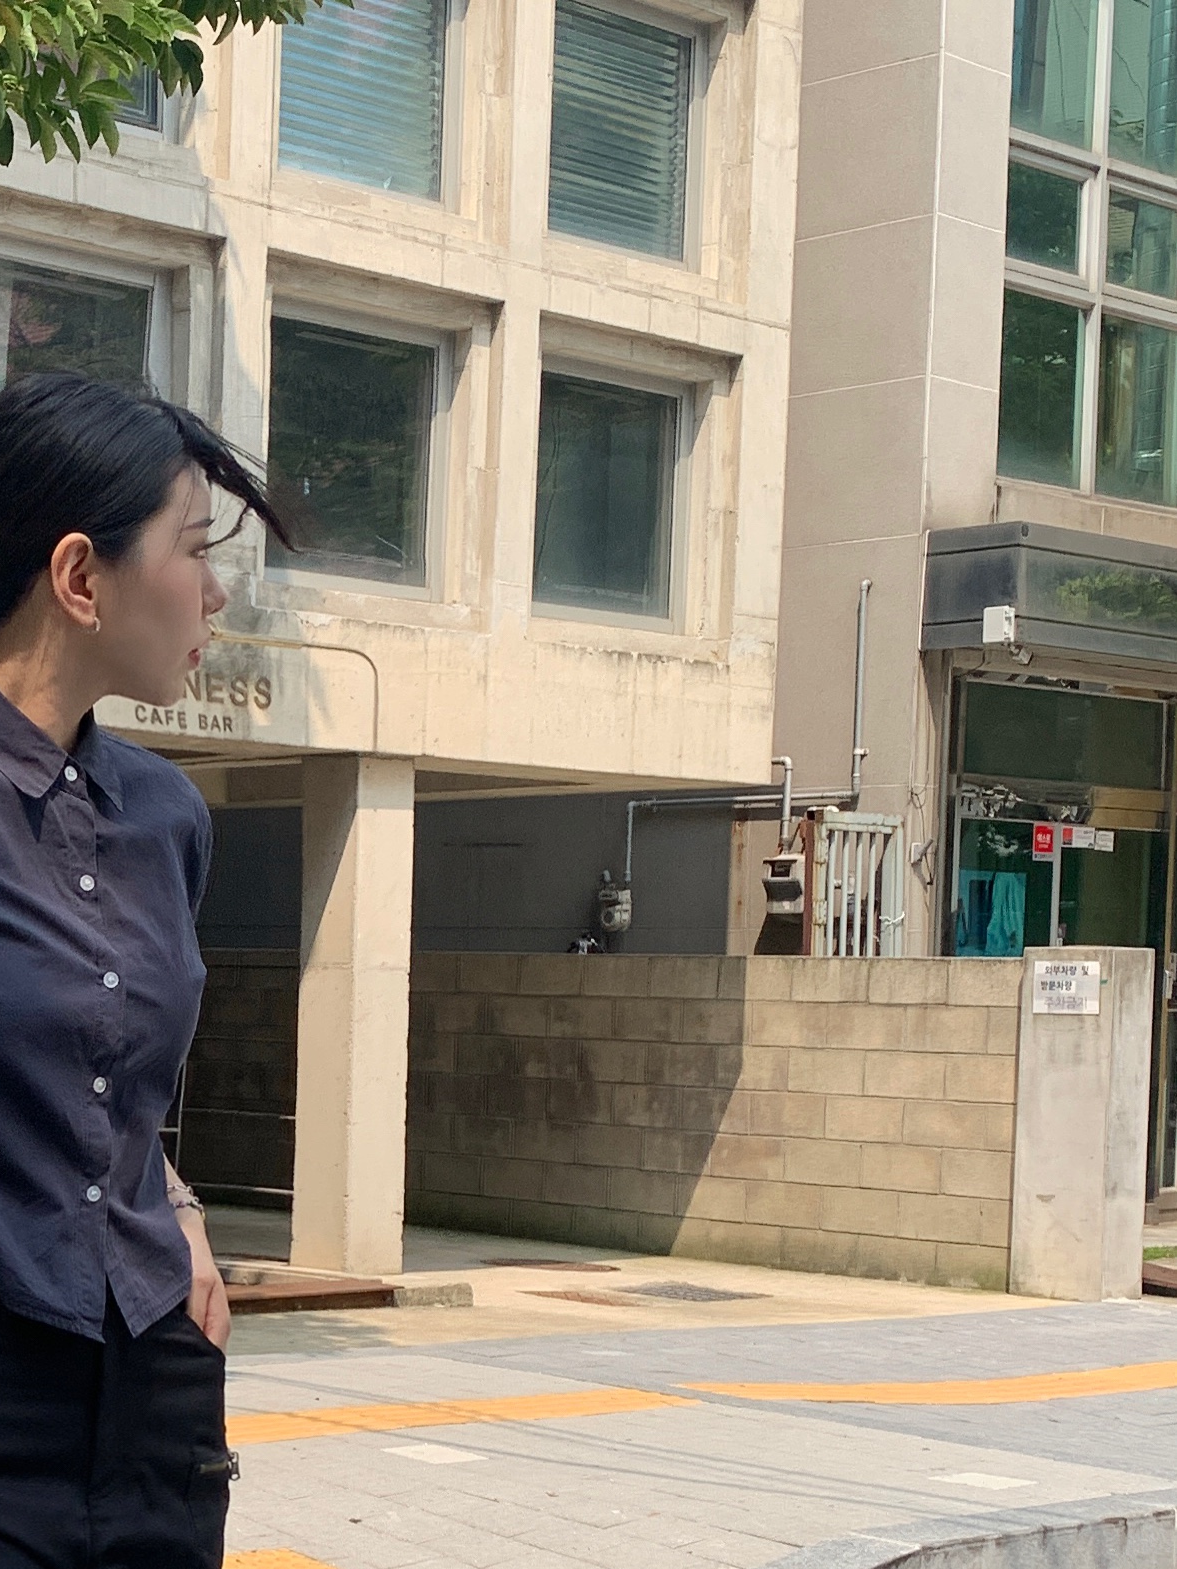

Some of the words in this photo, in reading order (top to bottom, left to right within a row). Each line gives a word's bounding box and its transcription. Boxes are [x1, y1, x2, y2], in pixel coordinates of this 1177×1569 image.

[183, 670, 272, 710] NESS
[135, 704, 188, 730] CAFE
[198, 713, 233, 733] BAR
